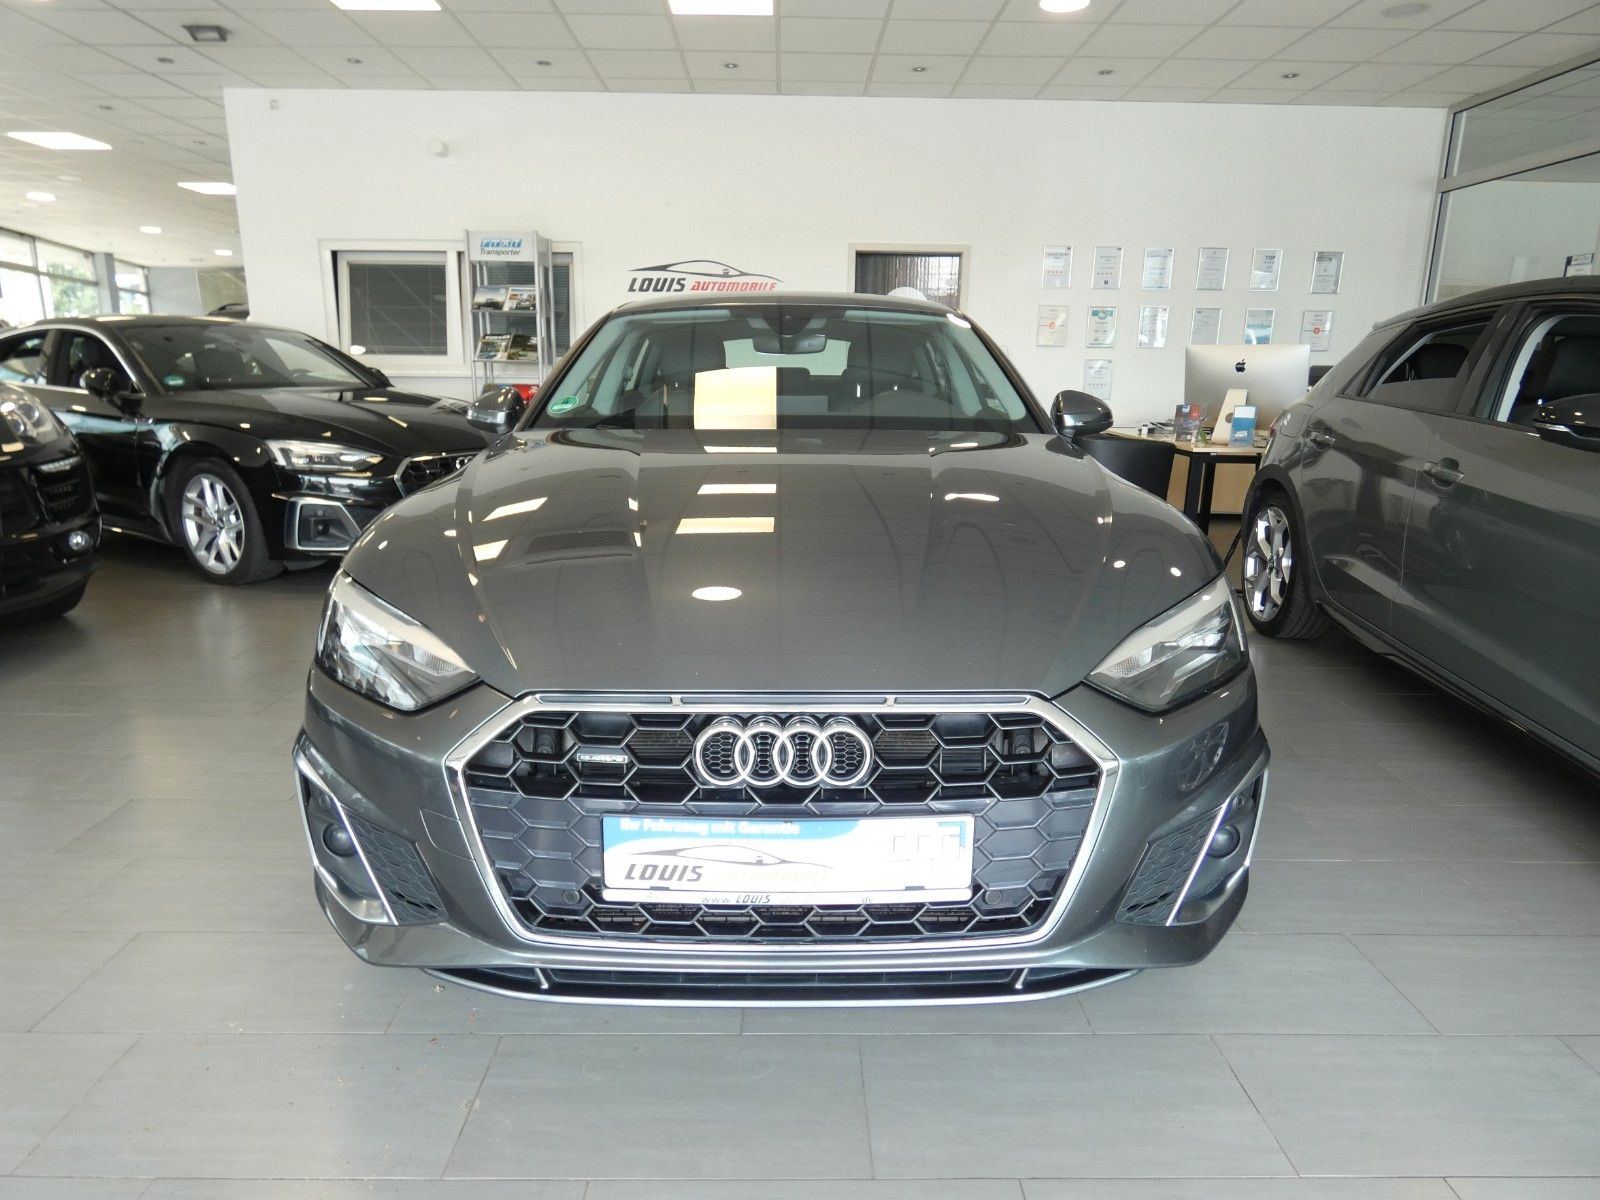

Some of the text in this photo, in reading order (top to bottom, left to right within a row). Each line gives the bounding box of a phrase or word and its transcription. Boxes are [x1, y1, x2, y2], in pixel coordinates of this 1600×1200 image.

[627, 277, 686, 292] LOUIS
[624, 863, 704, 882] LOUIS
[735, 894, 771, 904] LOUIS
